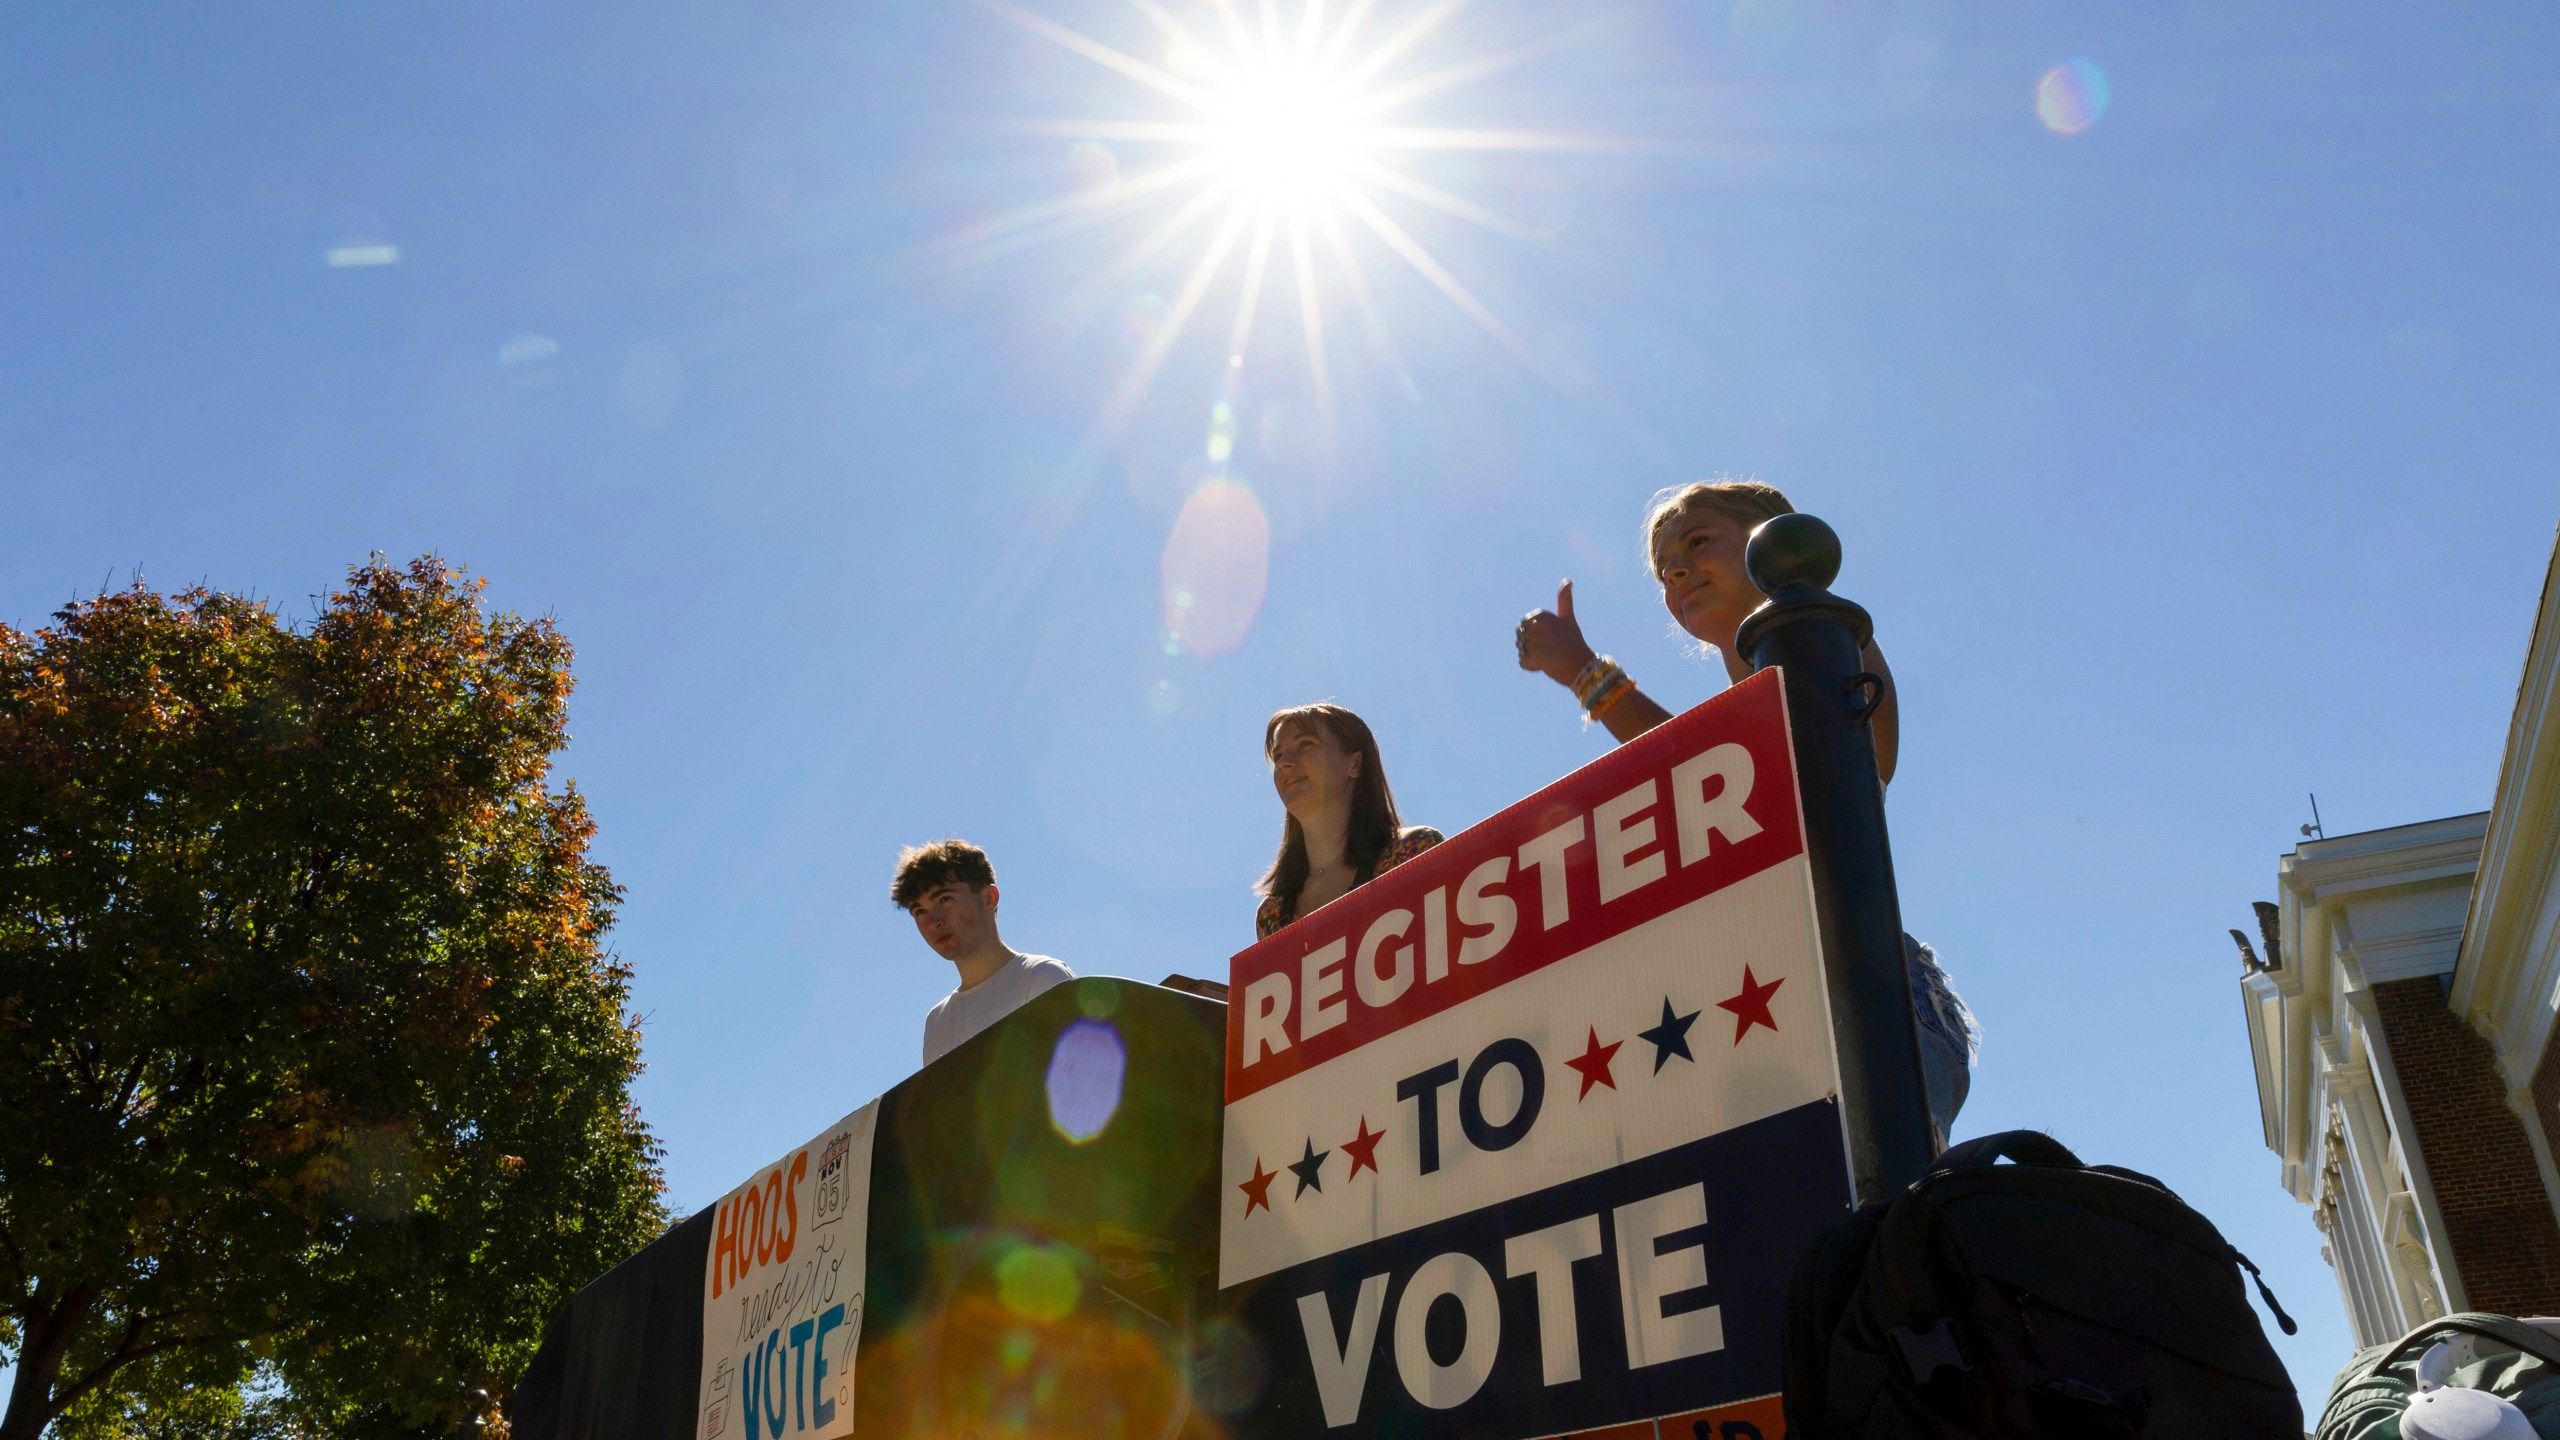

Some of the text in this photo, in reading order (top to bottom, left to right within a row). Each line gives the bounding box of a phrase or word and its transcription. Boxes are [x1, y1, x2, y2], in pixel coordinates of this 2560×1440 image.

[1242, 742, 1764, 1069] REGISTER
[820, 1156, 842, 1181] NOV
[1397, 1037, 1545, 1176] TO
[818, 1174, 840, 1217] 05
[735, 1233, 847, 1354] ready to
[1297, 1181, 1724, 1428] VOTE
[742, 1292, 863, 1440] VOTE?
